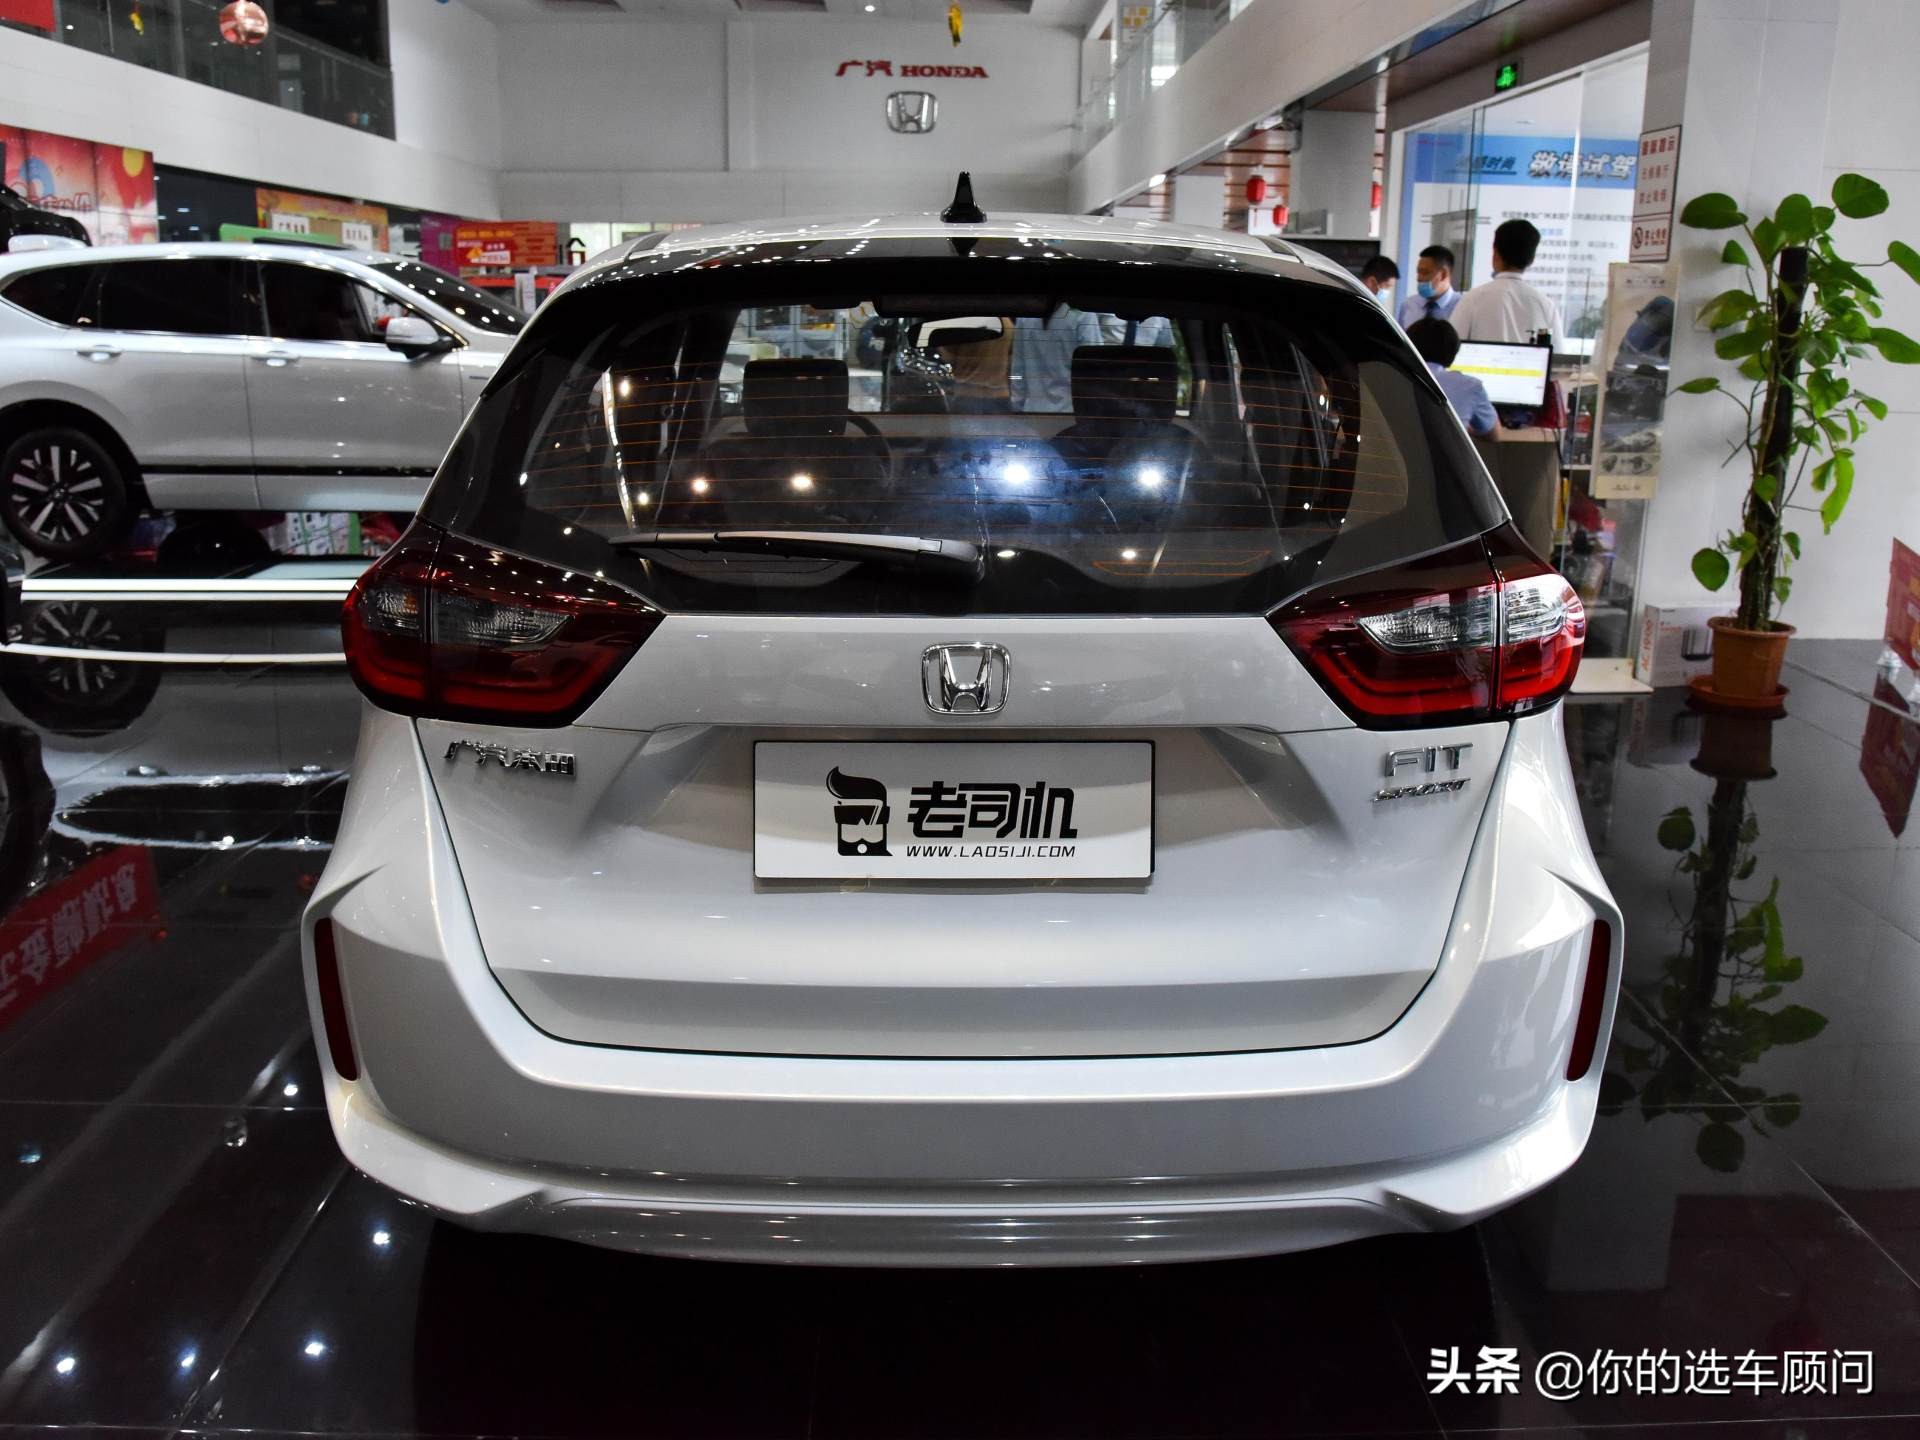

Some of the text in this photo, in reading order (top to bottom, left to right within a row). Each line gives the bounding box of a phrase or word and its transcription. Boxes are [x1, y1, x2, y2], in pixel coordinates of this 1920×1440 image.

[834, 60, 989, 78] 广汽 HONDA
[1528, 150, 1638, 179] 敬请试驾
[443, 740, 576, 776] 广汽本田
[1384, 742, 1474, 777] FIT
[1374, 778, 1472, 802] SPORT
[907, 781, 1078, 839] 老司机
[906, 845, 1076, 858] WWW.LAOSIJI.COM
